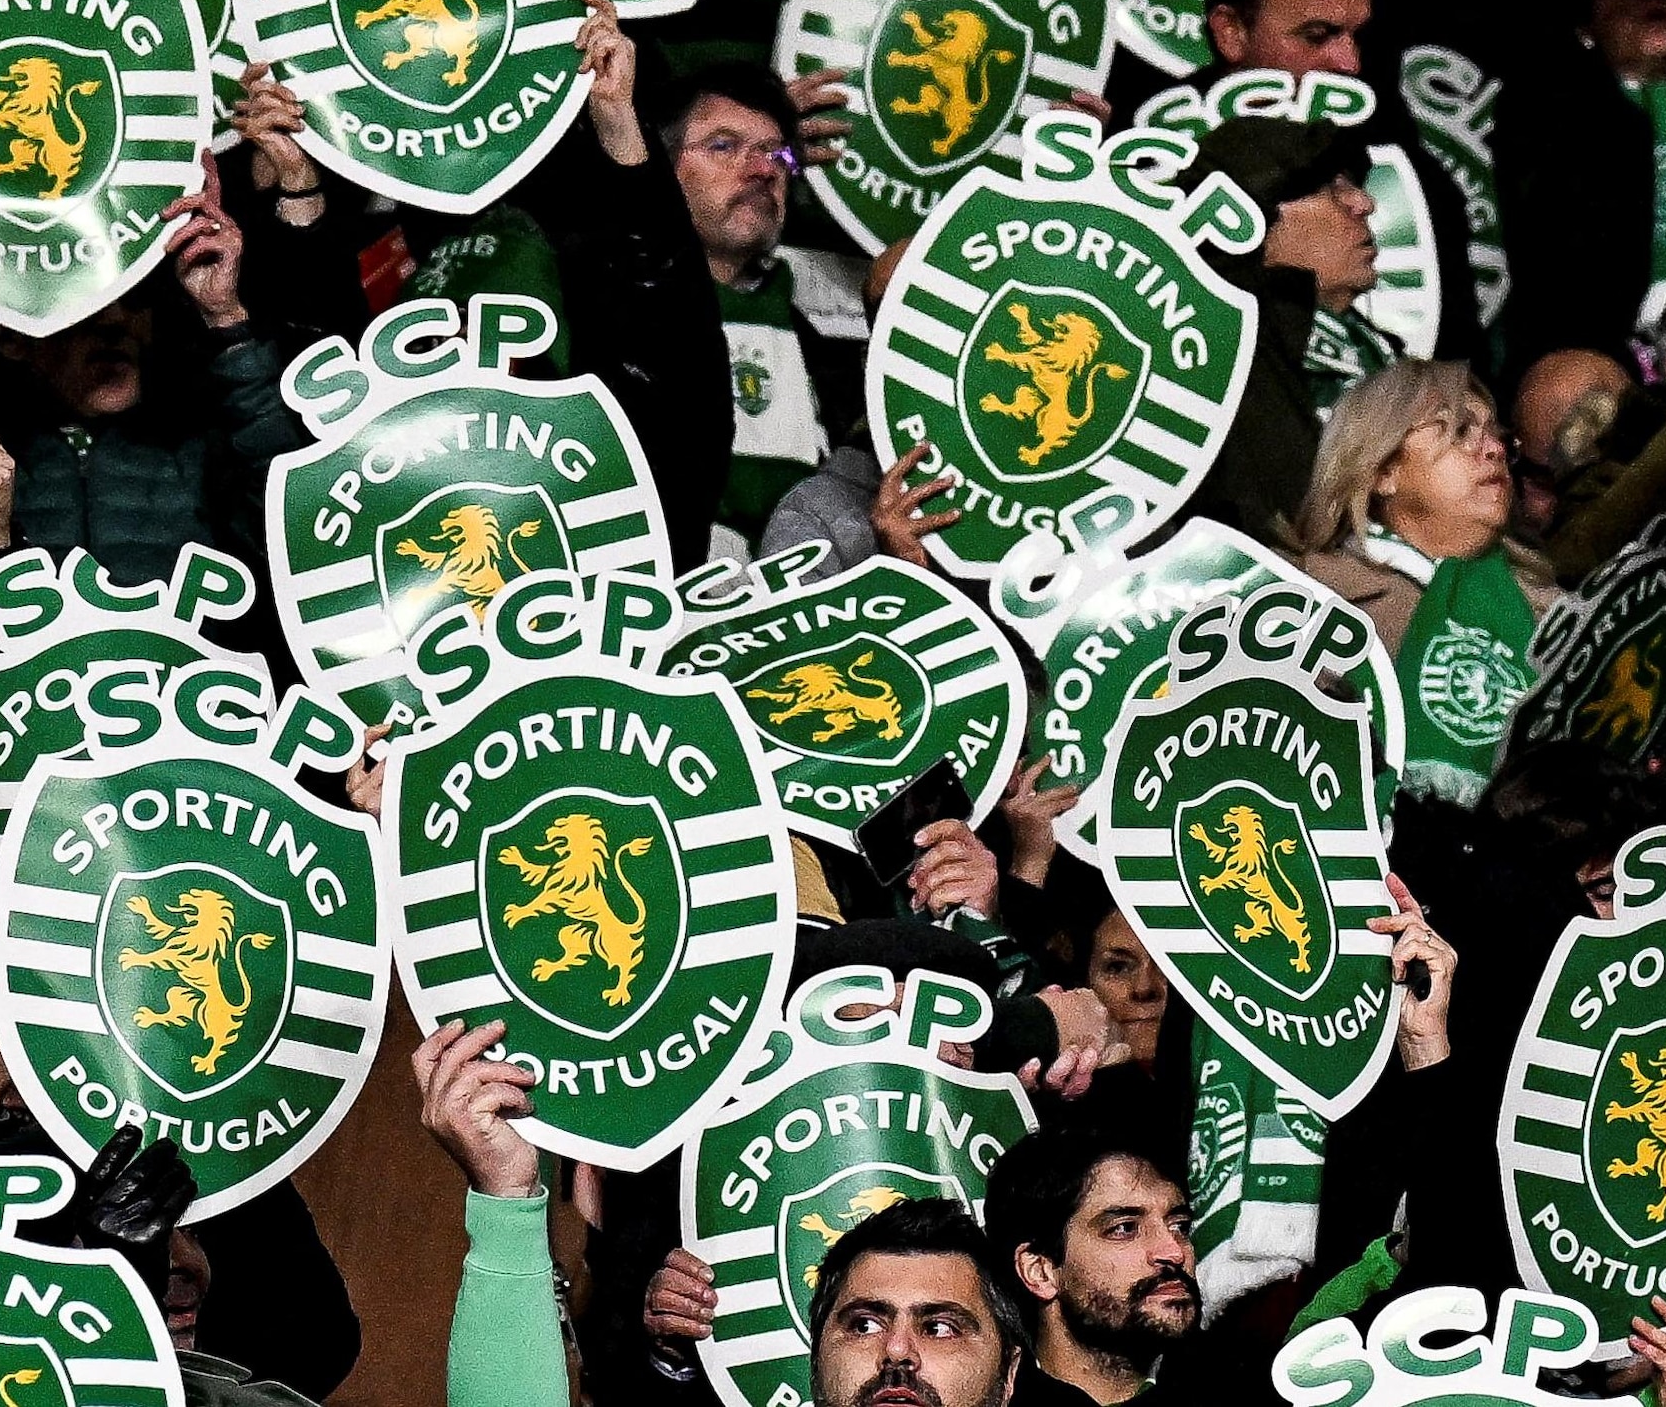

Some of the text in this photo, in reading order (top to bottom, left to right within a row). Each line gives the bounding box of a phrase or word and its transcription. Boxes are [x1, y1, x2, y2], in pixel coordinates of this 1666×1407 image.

[332, 67, 569, 161] PORTUGAL
[1029, 112, 1261, 251] SCP
[958, 214, 1209, 376] SPORTING
[284, 301, 549, 429] SCP
[310, 408, 599, 550] SPORTING
[403, 576, 677, 712] SCP
[1177, 595, 1370, 680] SCP
[83, 669, 355, 774] SCP
[418, 703, 720, 851] SPORTING
[1135, 707, 1343, 812] SPORTING
[50, 781, 351, 924] SPORTING
[1213, 973, 1394, 1051] PORTUGAL
[715, 1090, 1009, 1218] SPORTING
[1287, 1294, 1587, 1407] SCP
